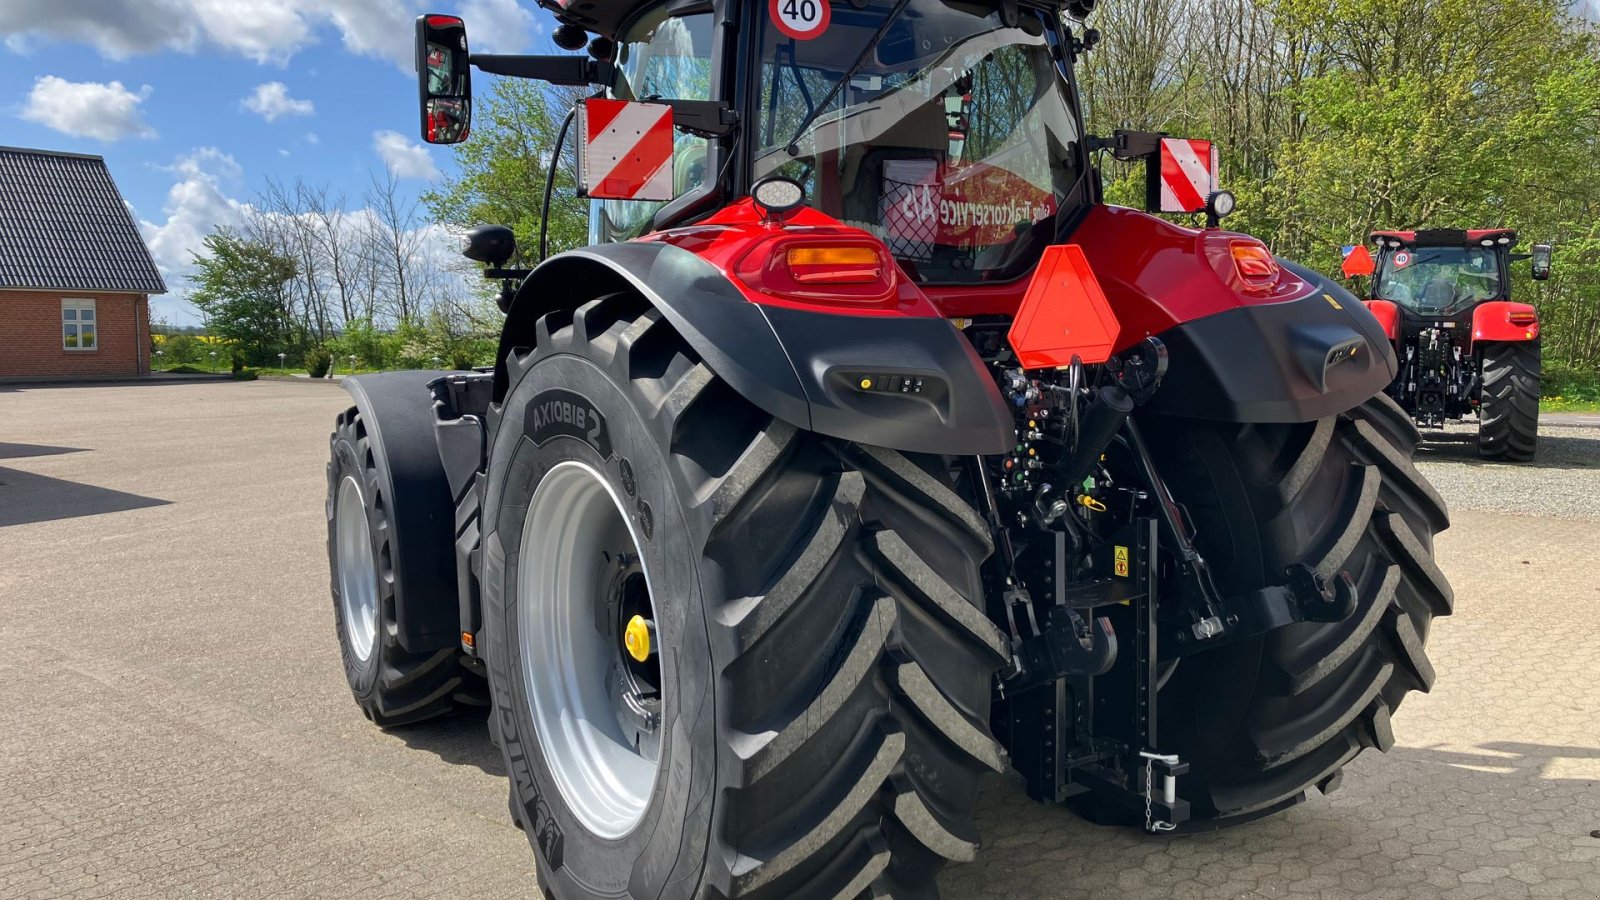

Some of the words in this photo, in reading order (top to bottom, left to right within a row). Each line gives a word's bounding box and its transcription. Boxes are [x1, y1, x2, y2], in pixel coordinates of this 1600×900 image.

[782, 0, 816, 22] 40
[532, 400, 586, 432] AXIOBIB
[587, 409, 601, 450] 2
